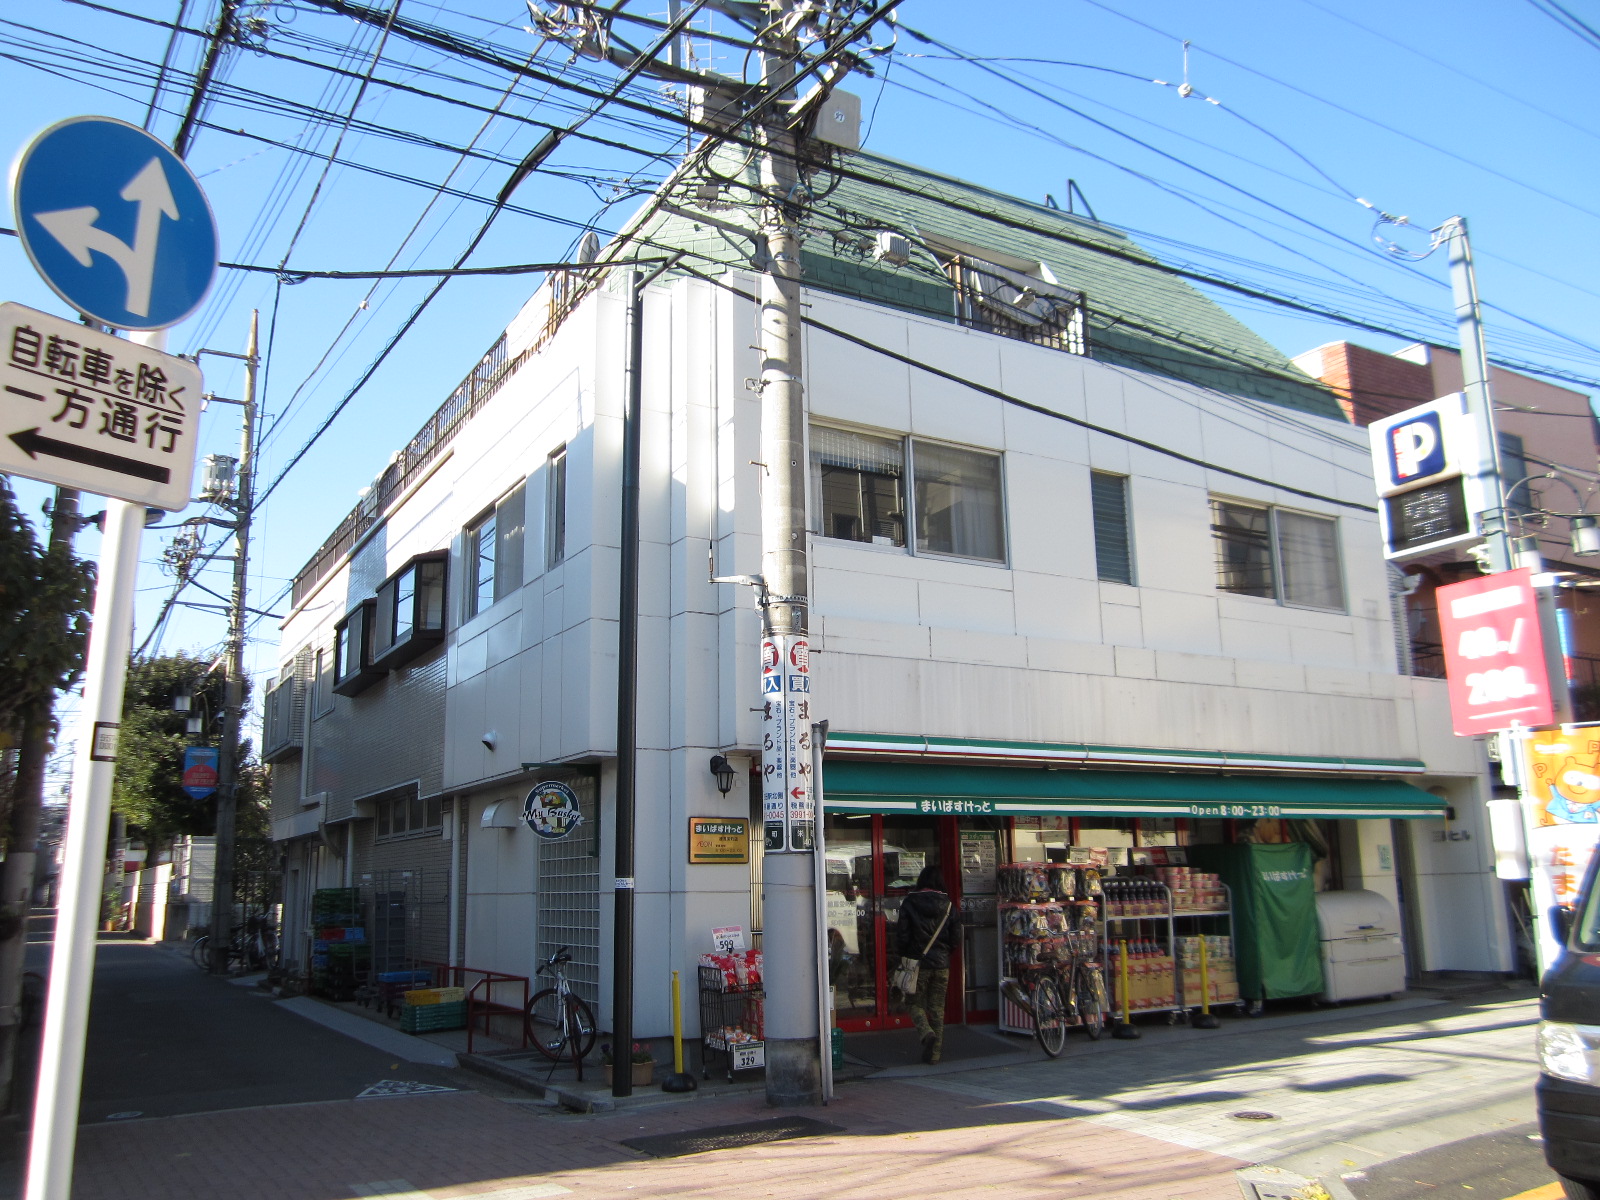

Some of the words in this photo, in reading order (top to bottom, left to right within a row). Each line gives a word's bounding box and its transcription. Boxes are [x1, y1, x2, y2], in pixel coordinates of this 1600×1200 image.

[11, 325, 186, 412] 自転車を除く
[5, 385, 184, 454] 一方通行
[920, 800, 991, 813] まいばすけっと
[1191, 805, 1219, 816] Open
[523, 808, 543, 820] My
[547, 807, 581, 821] Basket
[695, 824, 743, 834] まいばすけっと
[720, 940, 734, 951] 599
[741, 1056, 755, 1067] 329
